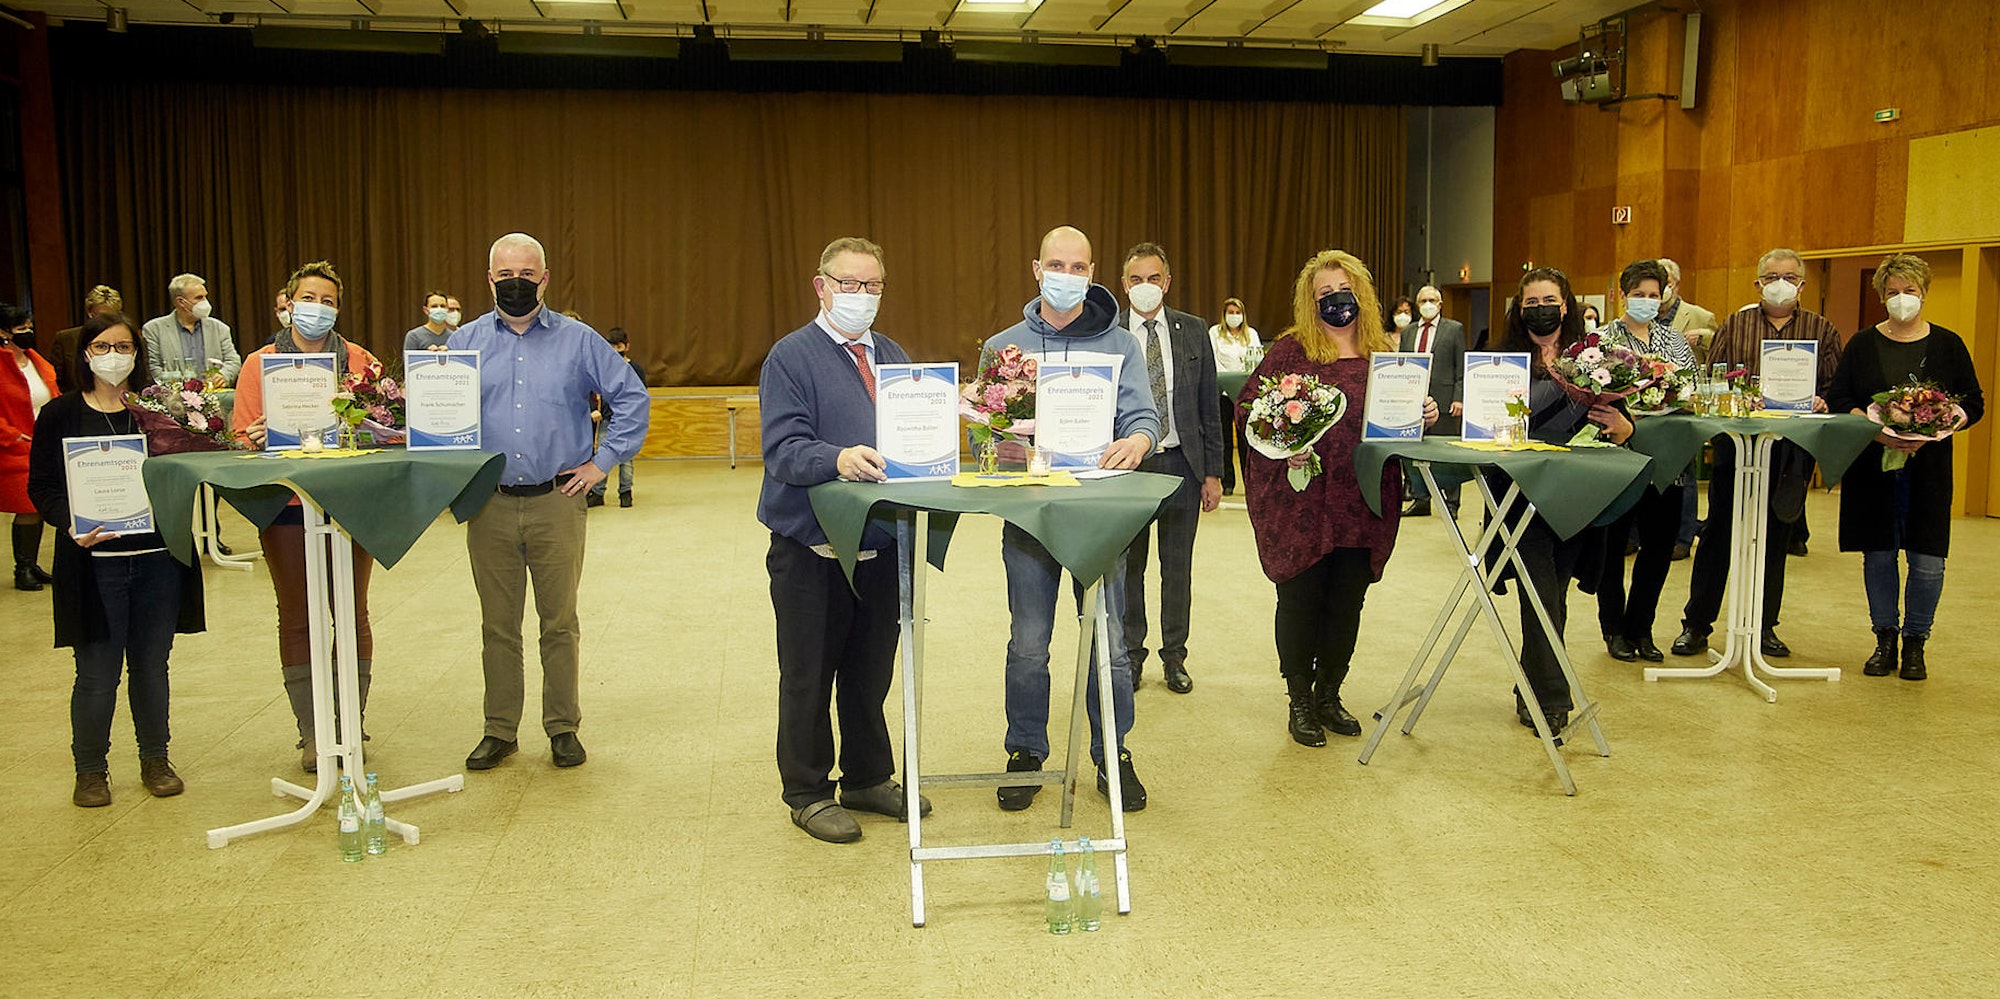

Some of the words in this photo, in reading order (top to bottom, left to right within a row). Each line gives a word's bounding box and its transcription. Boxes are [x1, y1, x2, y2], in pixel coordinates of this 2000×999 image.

[272, 376, 327, 384] Ehrenamtspreis
[416, 373, 470, 381] Ehrenamtspreis
[1047, 386, 1104, 394] Ehrenamtspreis
[888, 391, 947, 400] Ehrenamtspreis
[78, 458, 137, 468] Ehrenamtspreis
